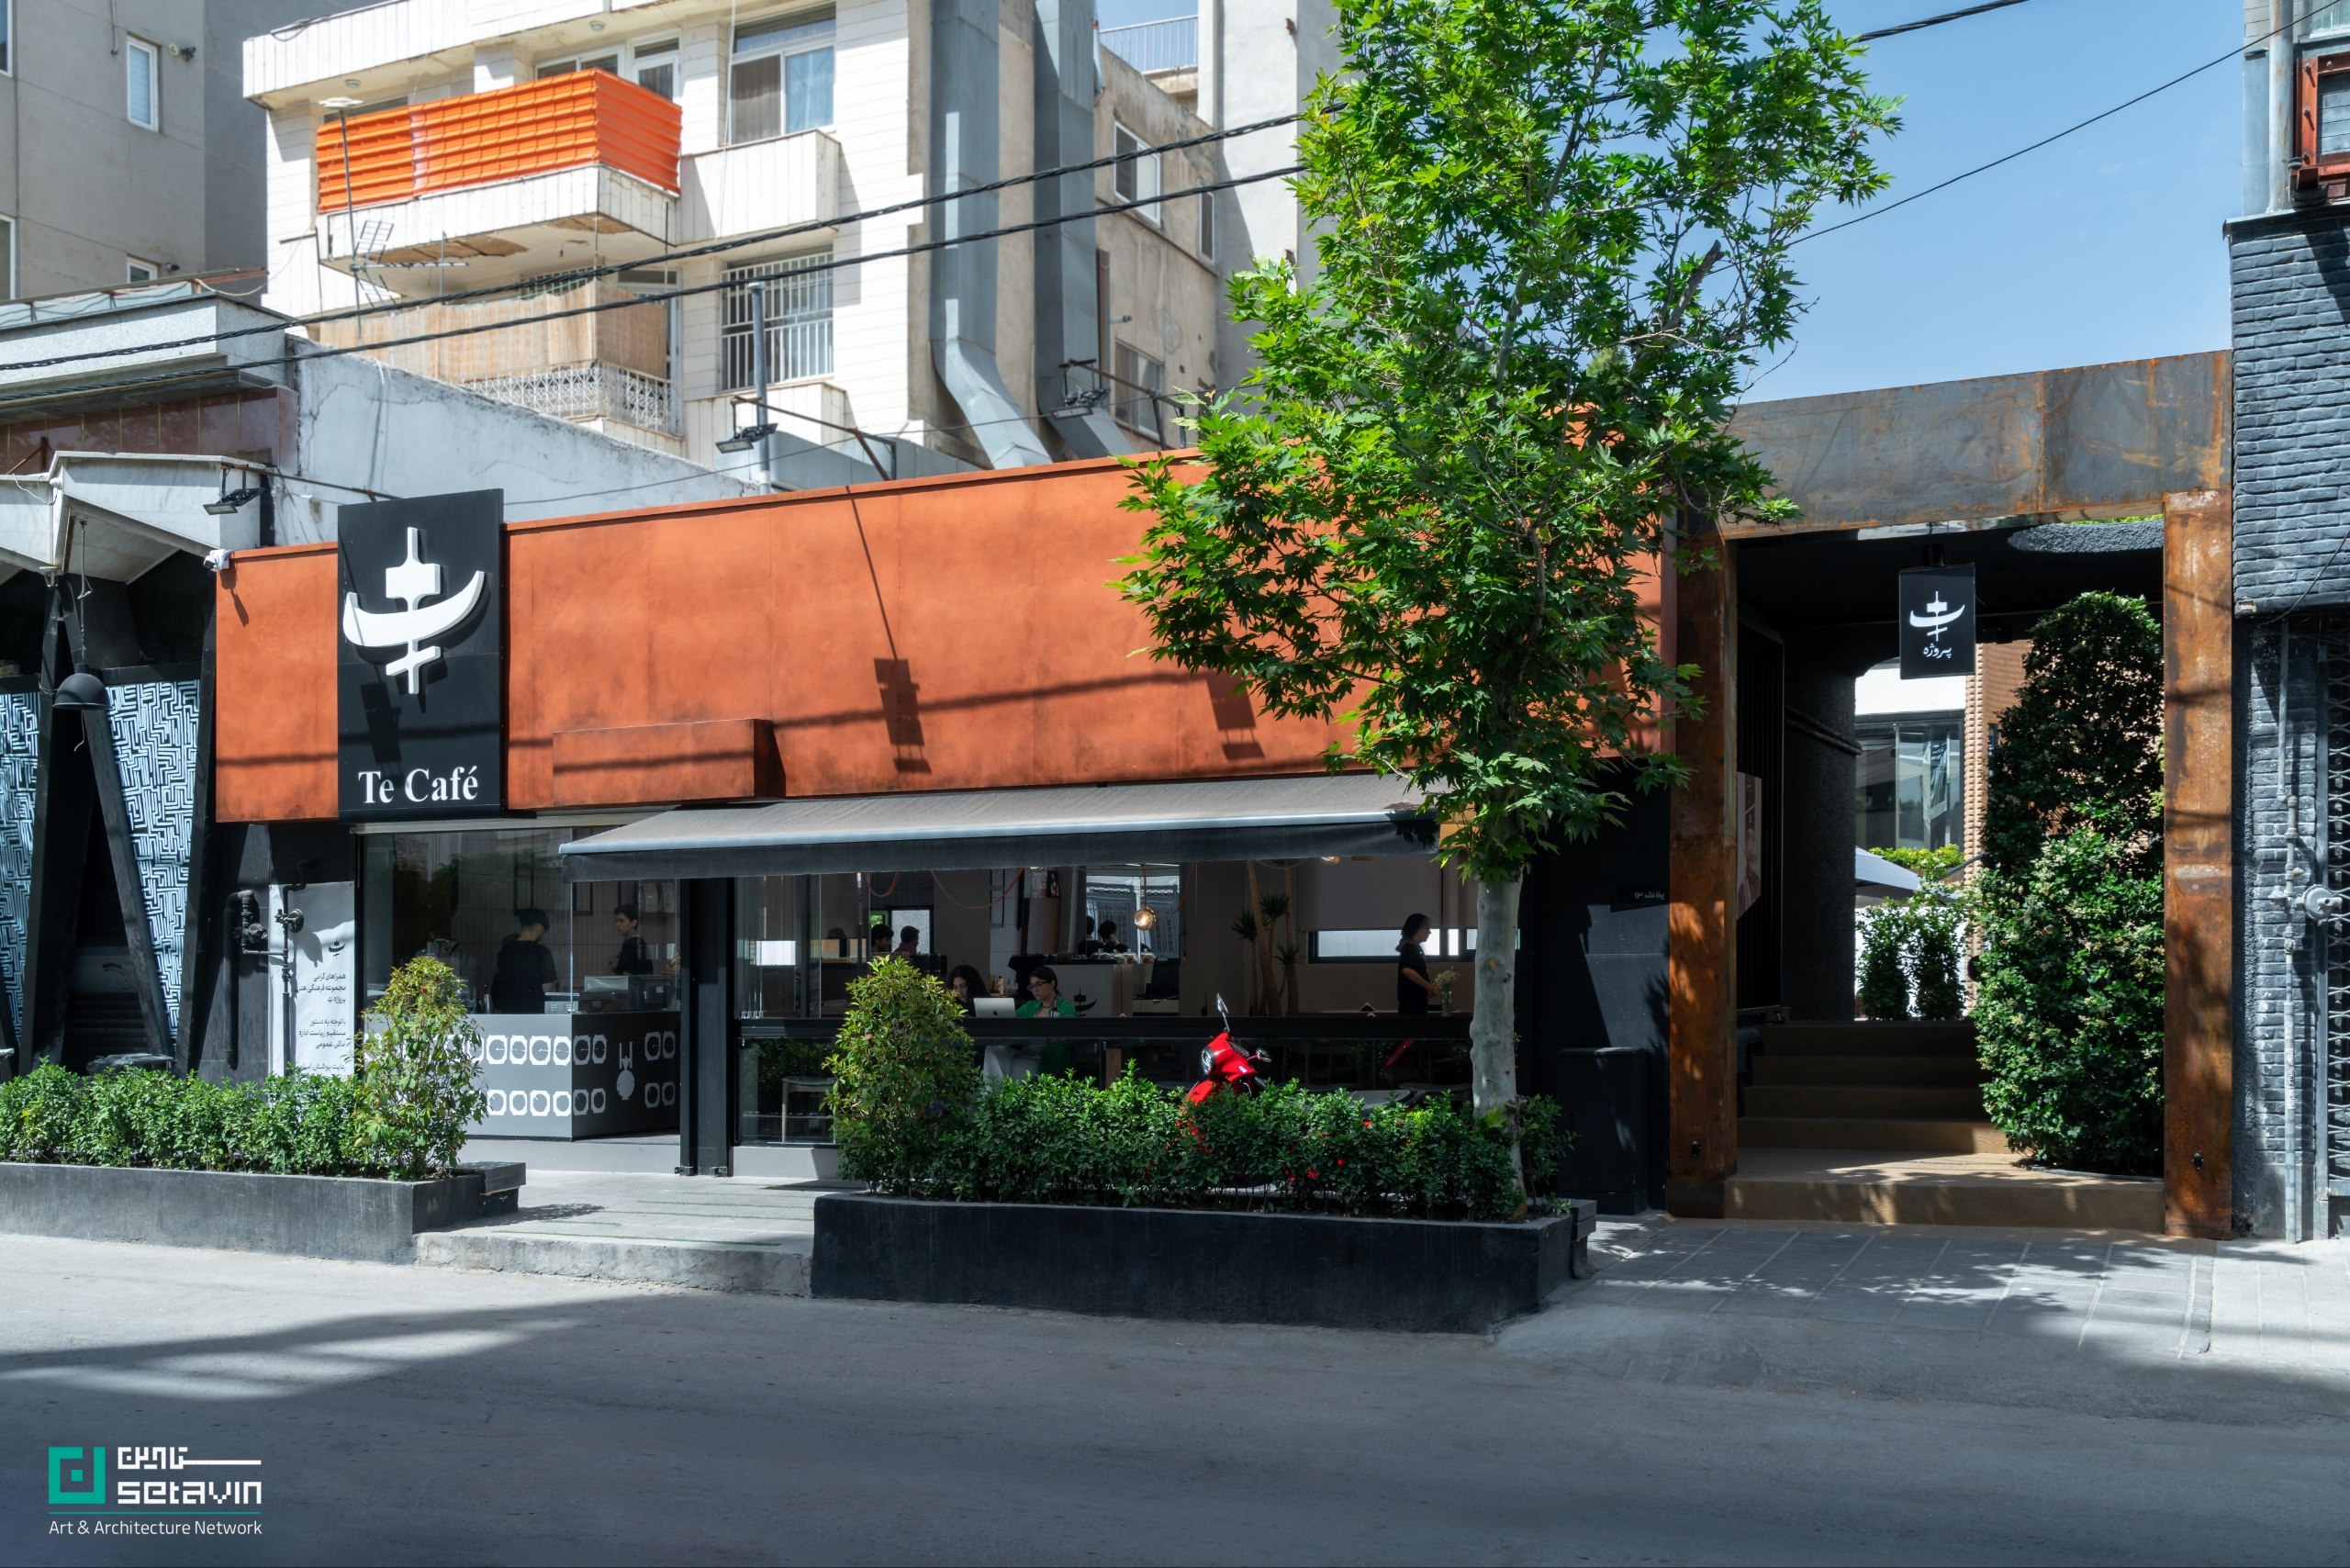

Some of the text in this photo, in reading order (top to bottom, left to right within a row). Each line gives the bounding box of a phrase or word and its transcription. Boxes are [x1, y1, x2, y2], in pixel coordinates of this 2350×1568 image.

[1923, 643, 1953, 658] پروژه
[358, 765, 478, 803] Te Café
[1644, 890, 1664, 900] پلاک
[308, 983, 324, 993] فرهنگی
[325, 984, 346, 992] مجموعه
